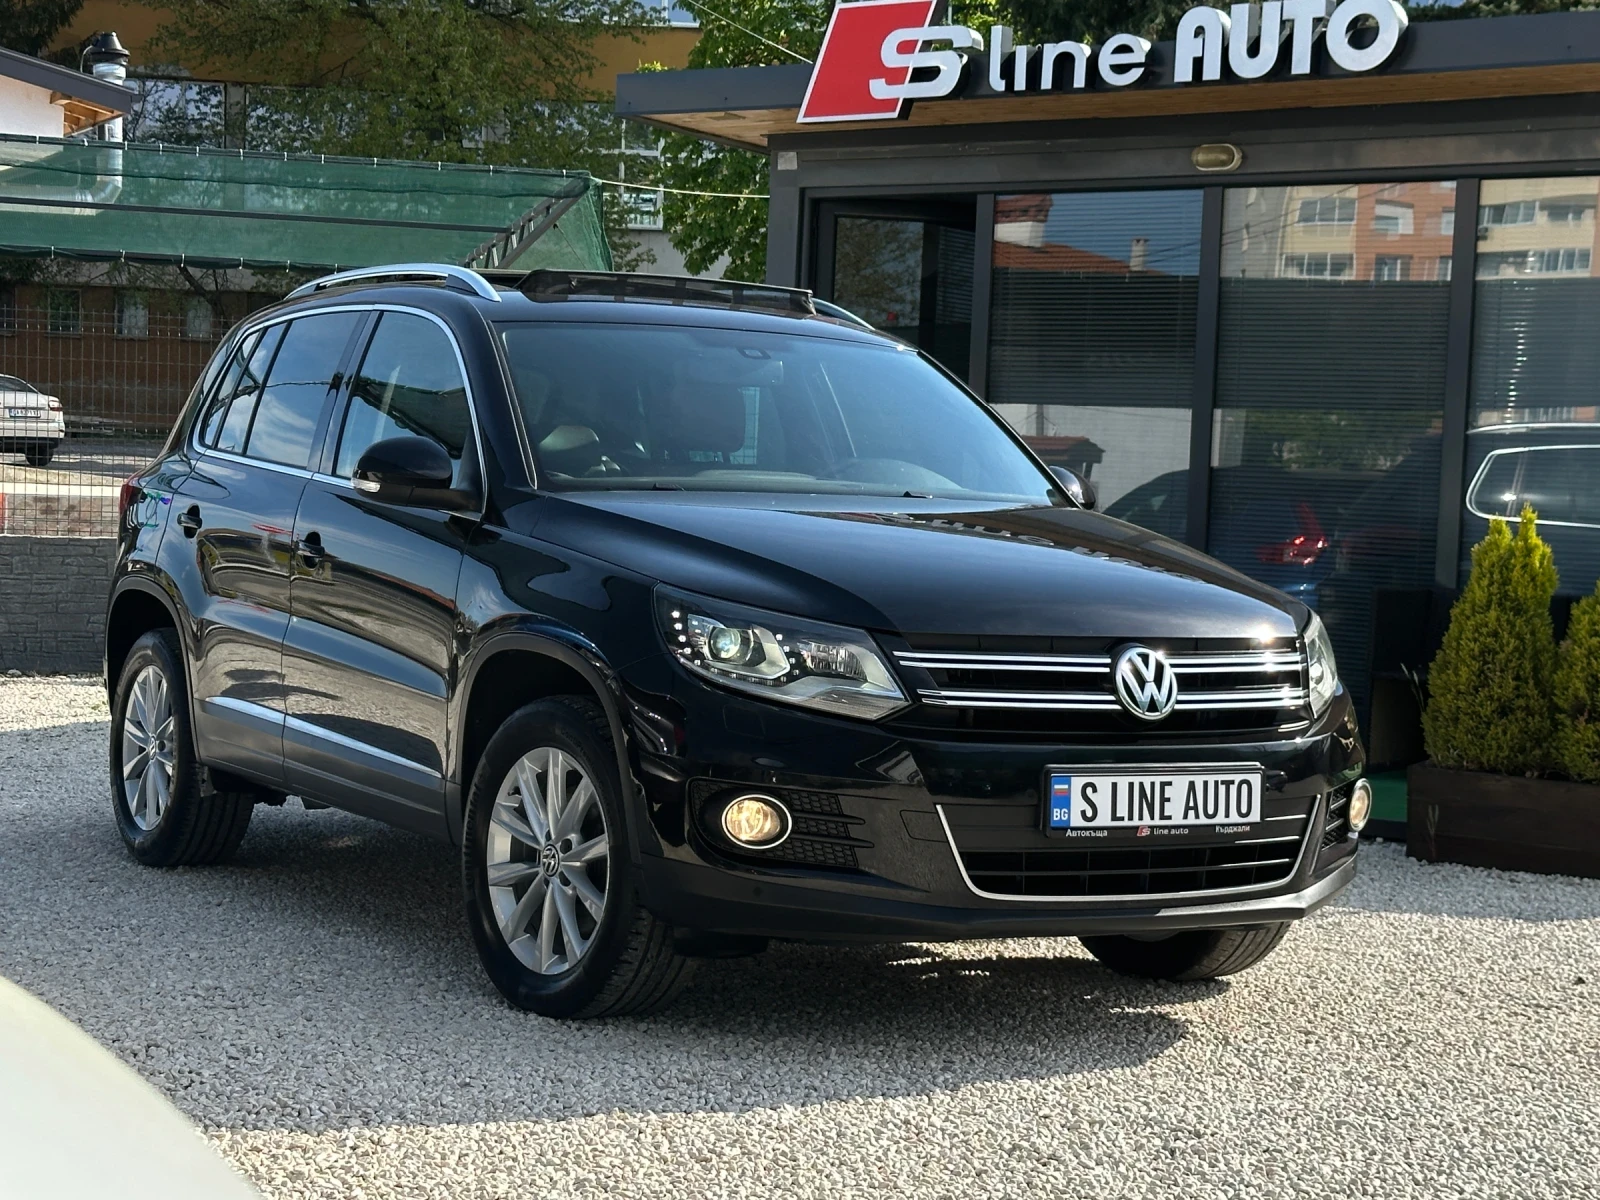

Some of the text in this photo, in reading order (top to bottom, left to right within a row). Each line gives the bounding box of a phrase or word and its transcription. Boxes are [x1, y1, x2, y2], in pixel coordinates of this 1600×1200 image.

[869, 25, 982, 99] S
[1174, 0, 1408, 83] AUTO
[1080, 779, 1253, 822] S LINE AUTO
[1053, 808, 1068, 821] BG
[1066, 828, 1108, 837] Автокъща
[1153, 826, 1169, 835] line
[1170, 827, 1189, 835] auto
[1215, 825, 1250, 834] Кърджали
